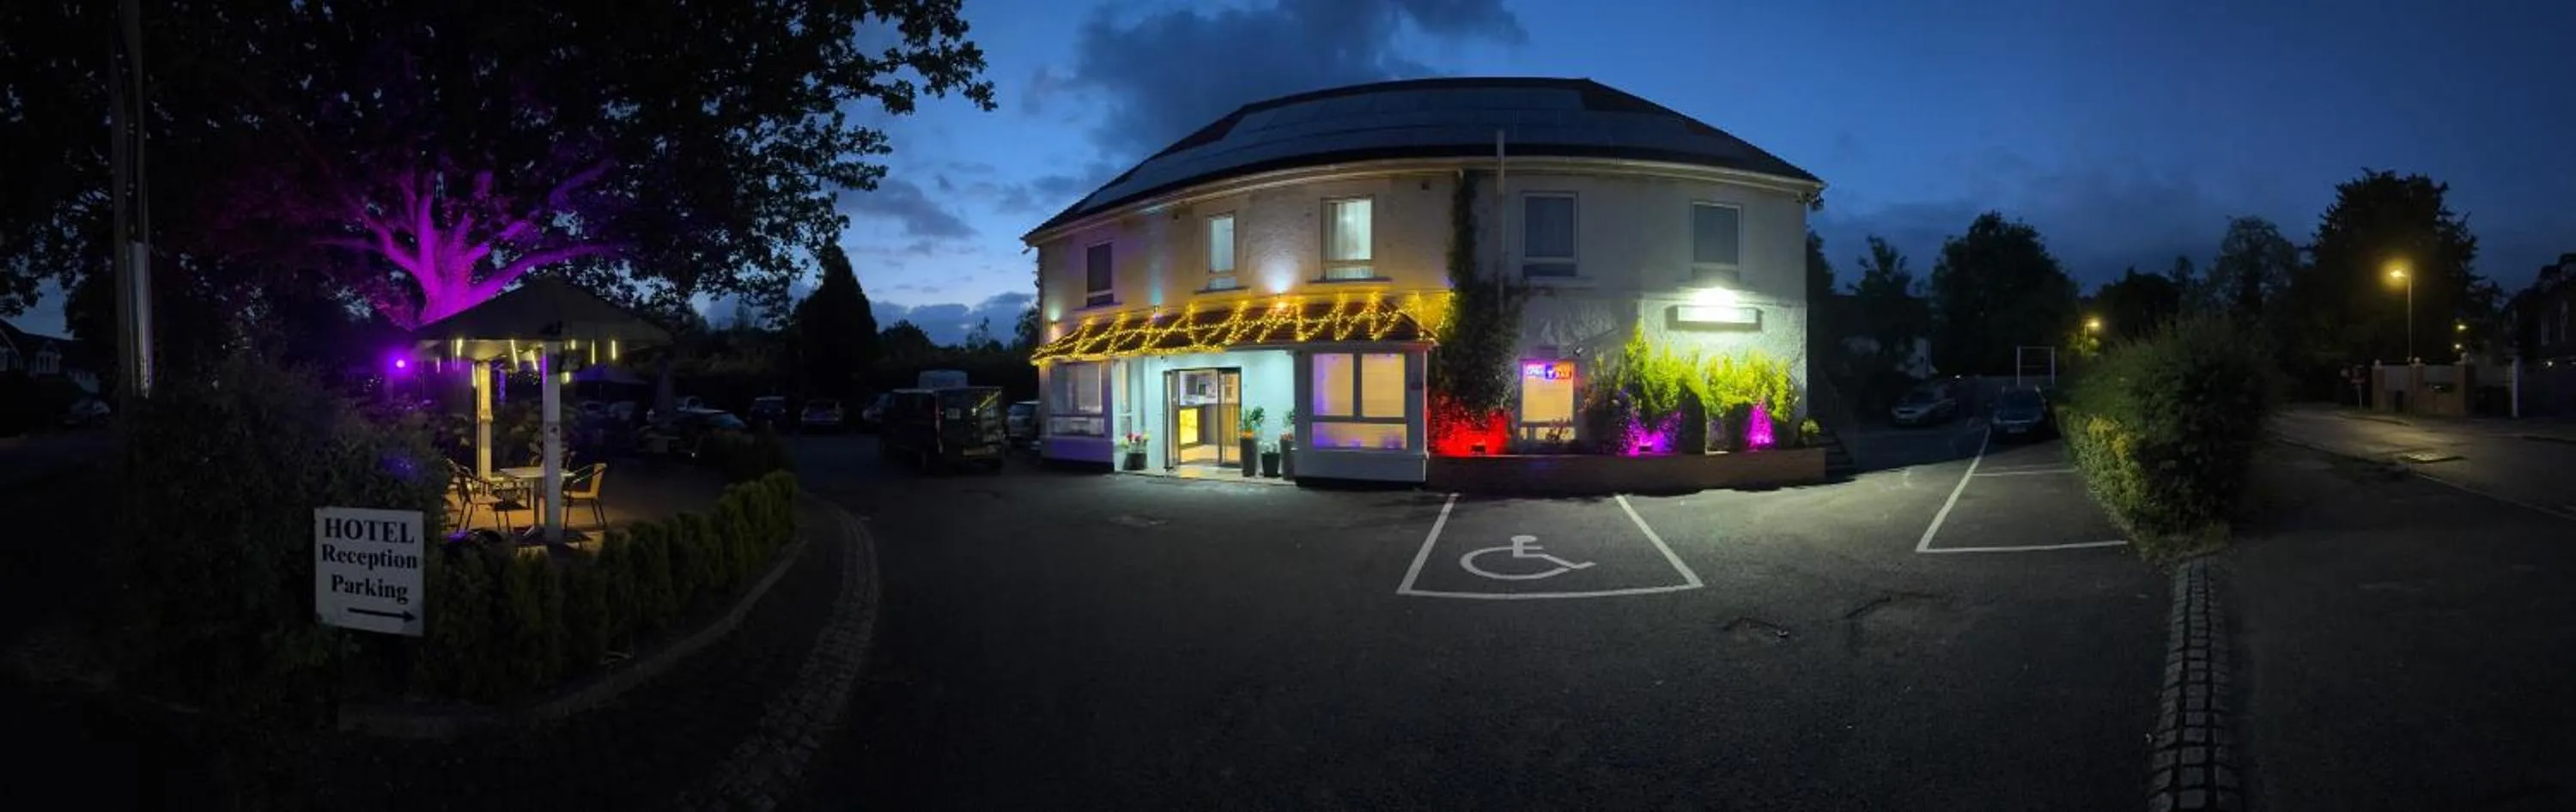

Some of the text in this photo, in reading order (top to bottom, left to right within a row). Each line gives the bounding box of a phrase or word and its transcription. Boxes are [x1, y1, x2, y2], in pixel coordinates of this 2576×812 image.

[325, 518, 415, 543] HOTEL
[321, 543, 418, 571] Reception
[331, 574, 409, 604] Parking
